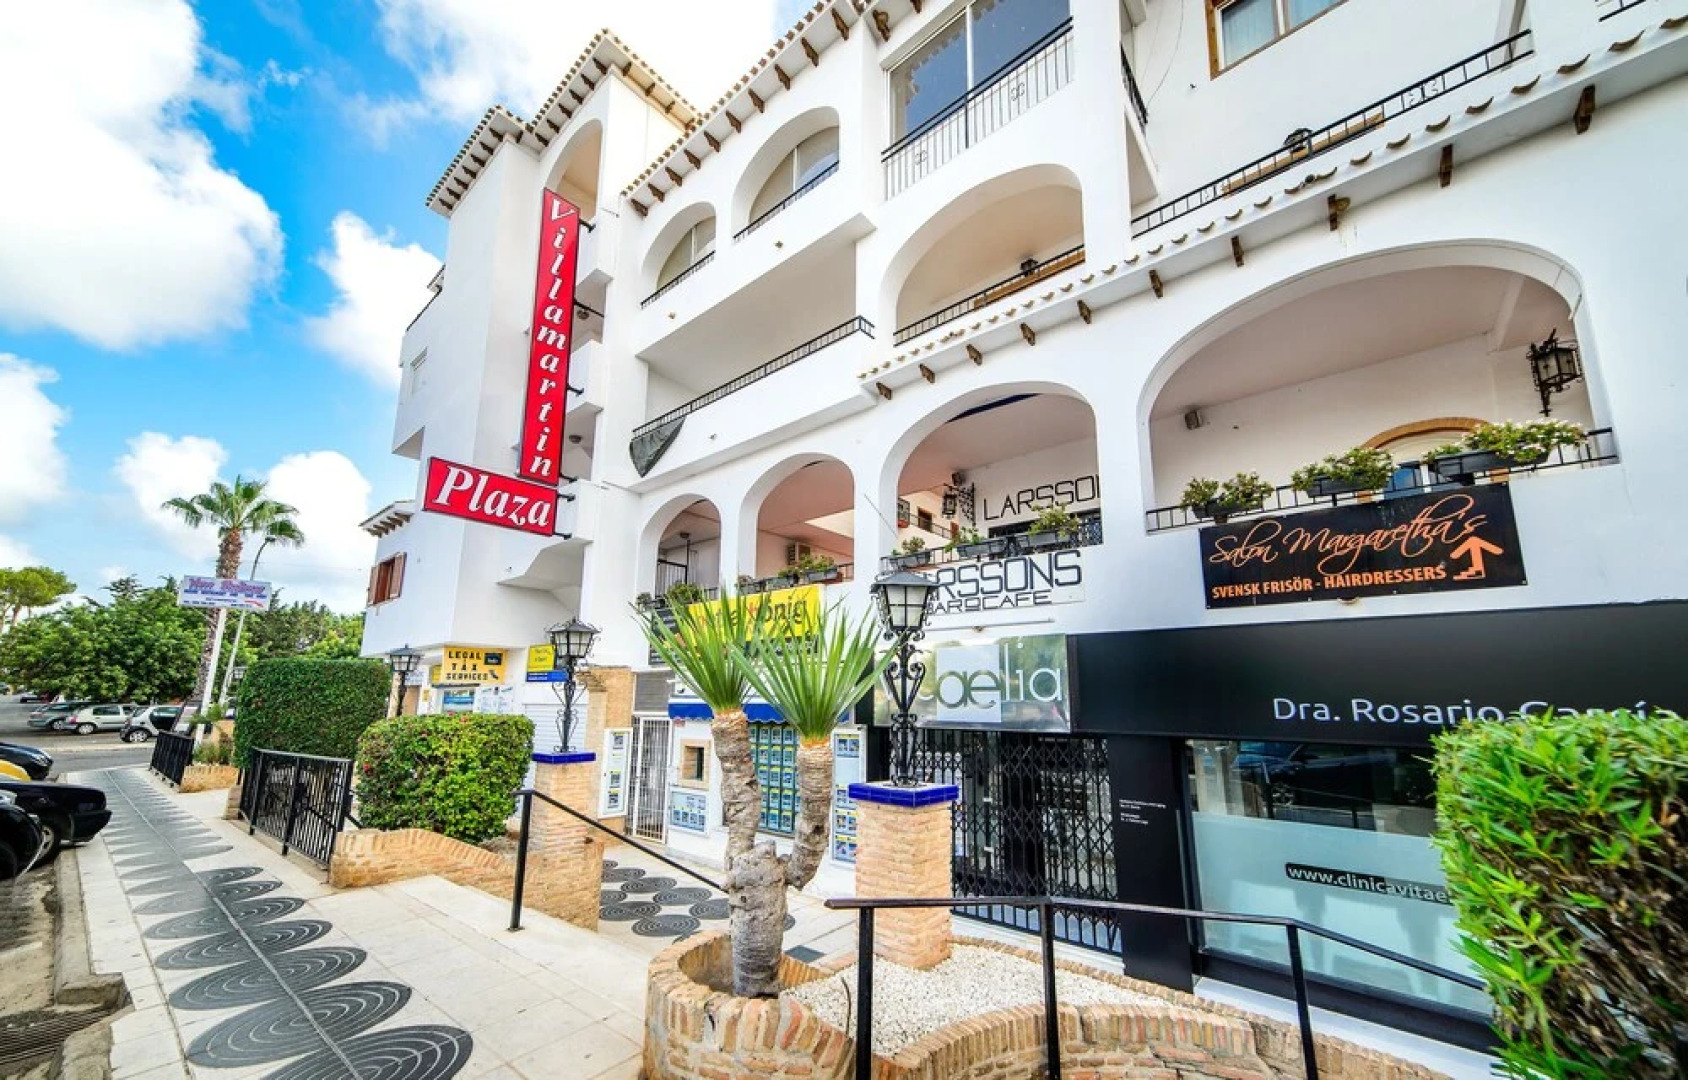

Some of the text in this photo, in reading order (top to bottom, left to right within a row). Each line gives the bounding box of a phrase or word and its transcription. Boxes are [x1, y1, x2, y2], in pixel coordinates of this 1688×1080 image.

[530, 198, 576, 476] Villamartin
[432, 465, 551, 526] Plaza
[984, 474, 1099, 520] LARSSO
[1209, 494, 1487, 576] Salon Margaretha's
[926, 550, 1083, 600] RSSONS
[1212, 582, 1261, 599] SVENSK
[1263, 576, 1313, 595] FRISÖR
[1323, 566, 1447, 589] HAIRDRESSERS
[446, 673, 488, 681] SERVICES
[448, 651, 481, 660] LEGAL
[1273, 697, 1341, 722] Dra.
[1351, 698, 1504, 726] Rosario
